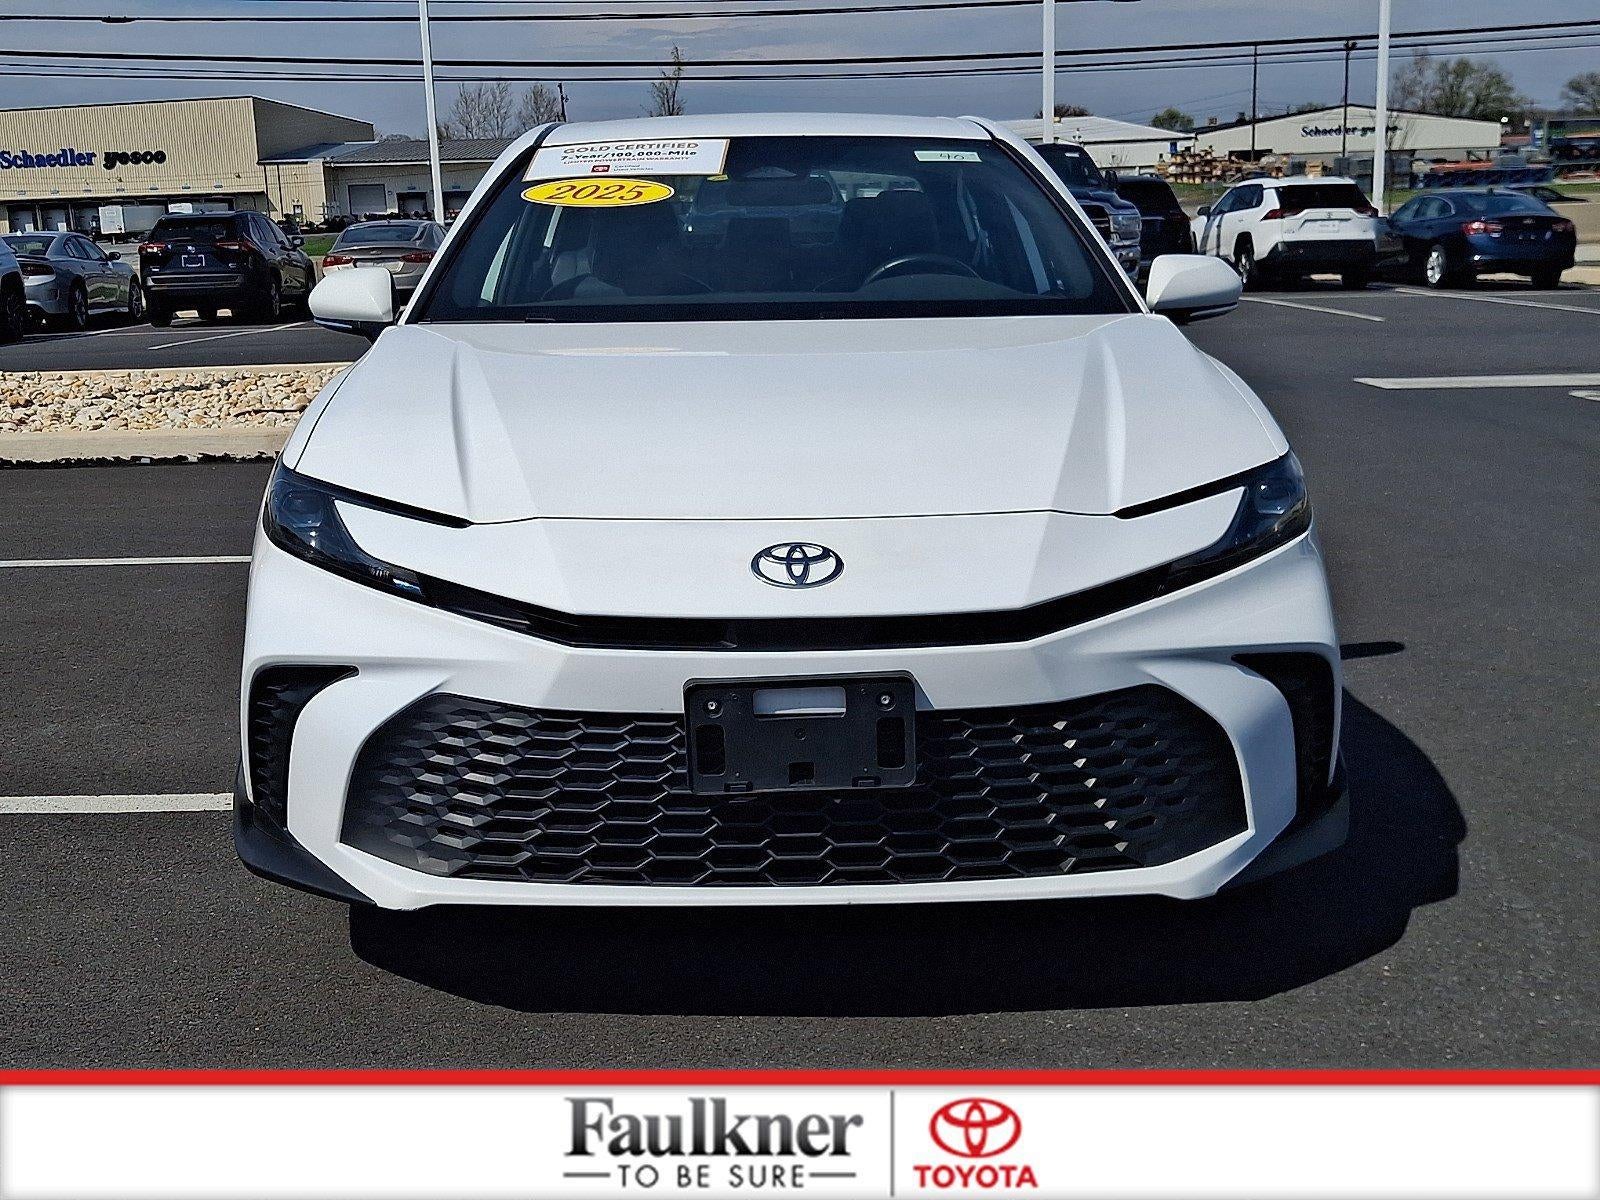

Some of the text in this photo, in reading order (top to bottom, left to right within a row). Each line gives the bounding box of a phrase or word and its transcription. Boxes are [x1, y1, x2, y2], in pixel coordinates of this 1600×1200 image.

[1301, 125, 1357, 137] Schaeder
[563, 142, 699, 153] GOLD CERTIFIED
[0, 148, 97, 169] Schaedler
[560, 150, 698, 161] 7-Year/100,000-Mile
[545, 184, 651, 200] 2025
